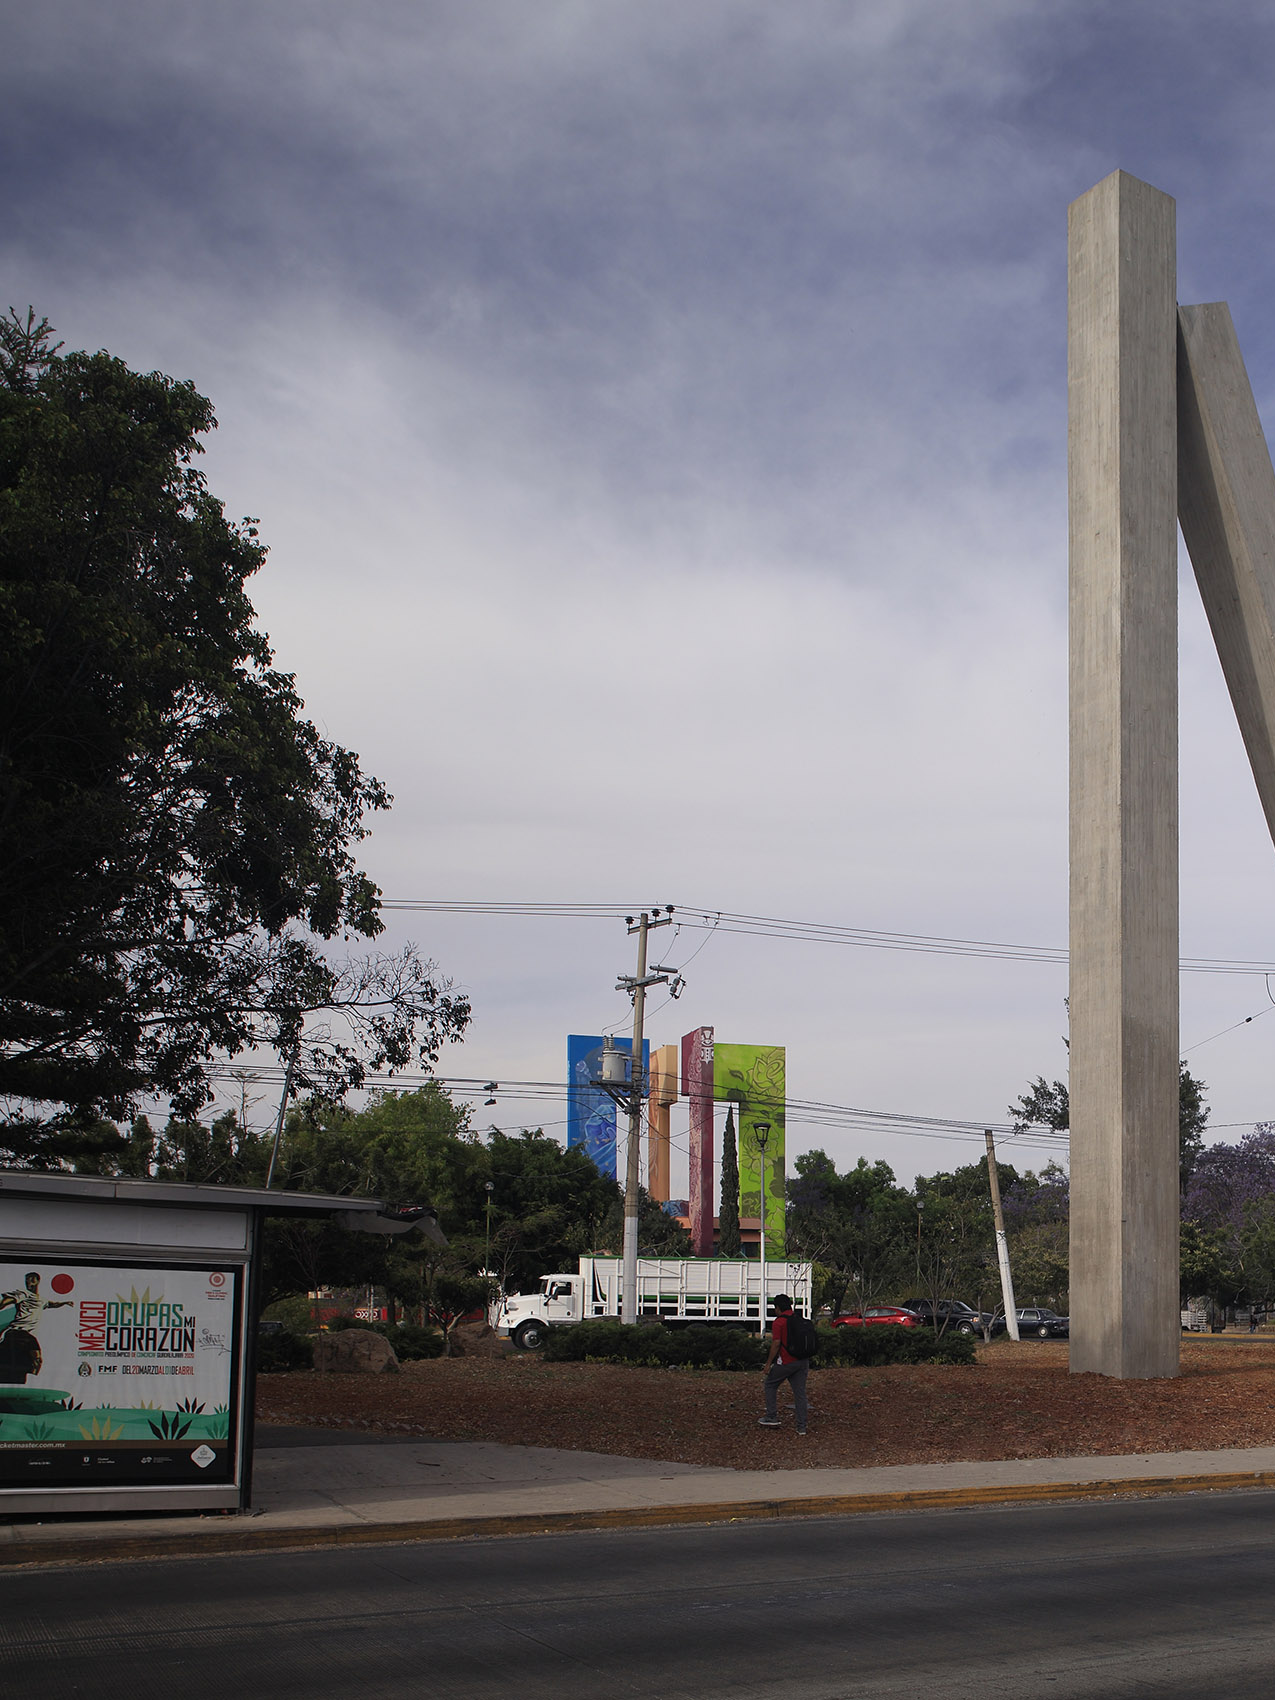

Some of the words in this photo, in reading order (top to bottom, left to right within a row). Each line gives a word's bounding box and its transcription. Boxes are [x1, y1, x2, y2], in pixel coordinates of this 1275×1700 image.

[75, 1301, 107, 1351] MÉXICO
[107, 1302, 184, 1328] OCUPAS
[184, 1316, 196, 1328] MI
[107, 1327, 195, 1352] CORAZÓN
[99, 1365, 118, 1373] FMF
